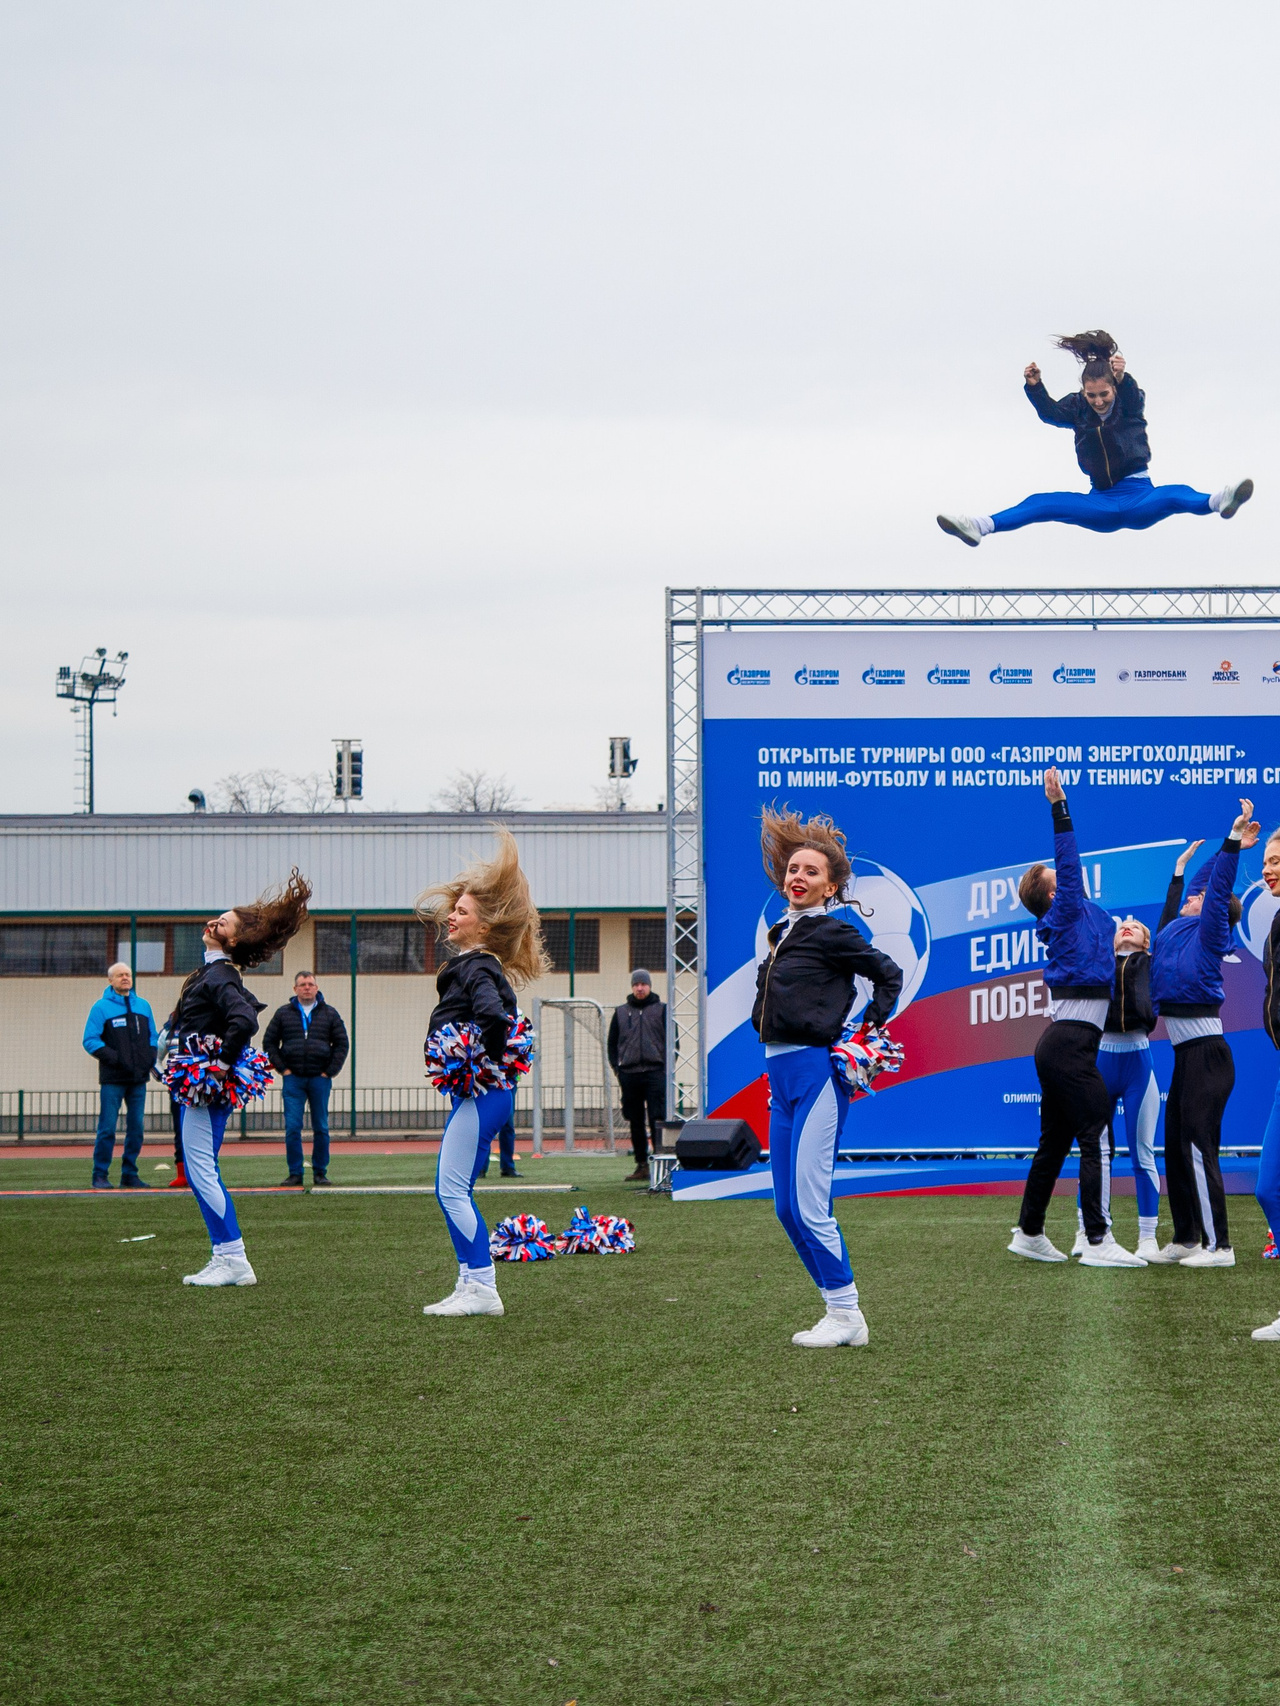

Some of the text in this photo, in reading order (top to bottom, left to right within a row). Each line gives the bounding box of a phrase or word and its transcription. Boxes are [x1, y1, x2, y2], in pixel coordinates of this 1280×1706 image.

[741, 670, 770, 678] ГАЗПРОМ
[809, 670, 839, 678] ГАЗПРОМ
[875, 669, 905, 678] ГАЗПРОМ
[941, 669, 970, 678] ГАЗПРОМ
[1003, 669, 1033, 677] ГАЗПРОМ
[1066, 668, 1096, 677] ГАЗПРОМ
[1134, 670, 1187, 678] ГАЗПРОМБАНК
[758, 745, 1246, 764] ОТКРЫТЫЕ ТУРНИРЫ ООО «ГАЗПРОМ ЭНЕРГОХОЛДИНГ»
[758, 771, 781, 787] ПО
[787, 770, 929, 787] МИНИ-ФУТБОЛУ
[935, 770, 946, 786] И
[952, 769, 1081, 786] НАСТОЛЬНМУ
[1087, 768, 1164, 785] ТЕННИСУ
[1169, 768, 1257, 784] «ЭНЕРГИЯ
